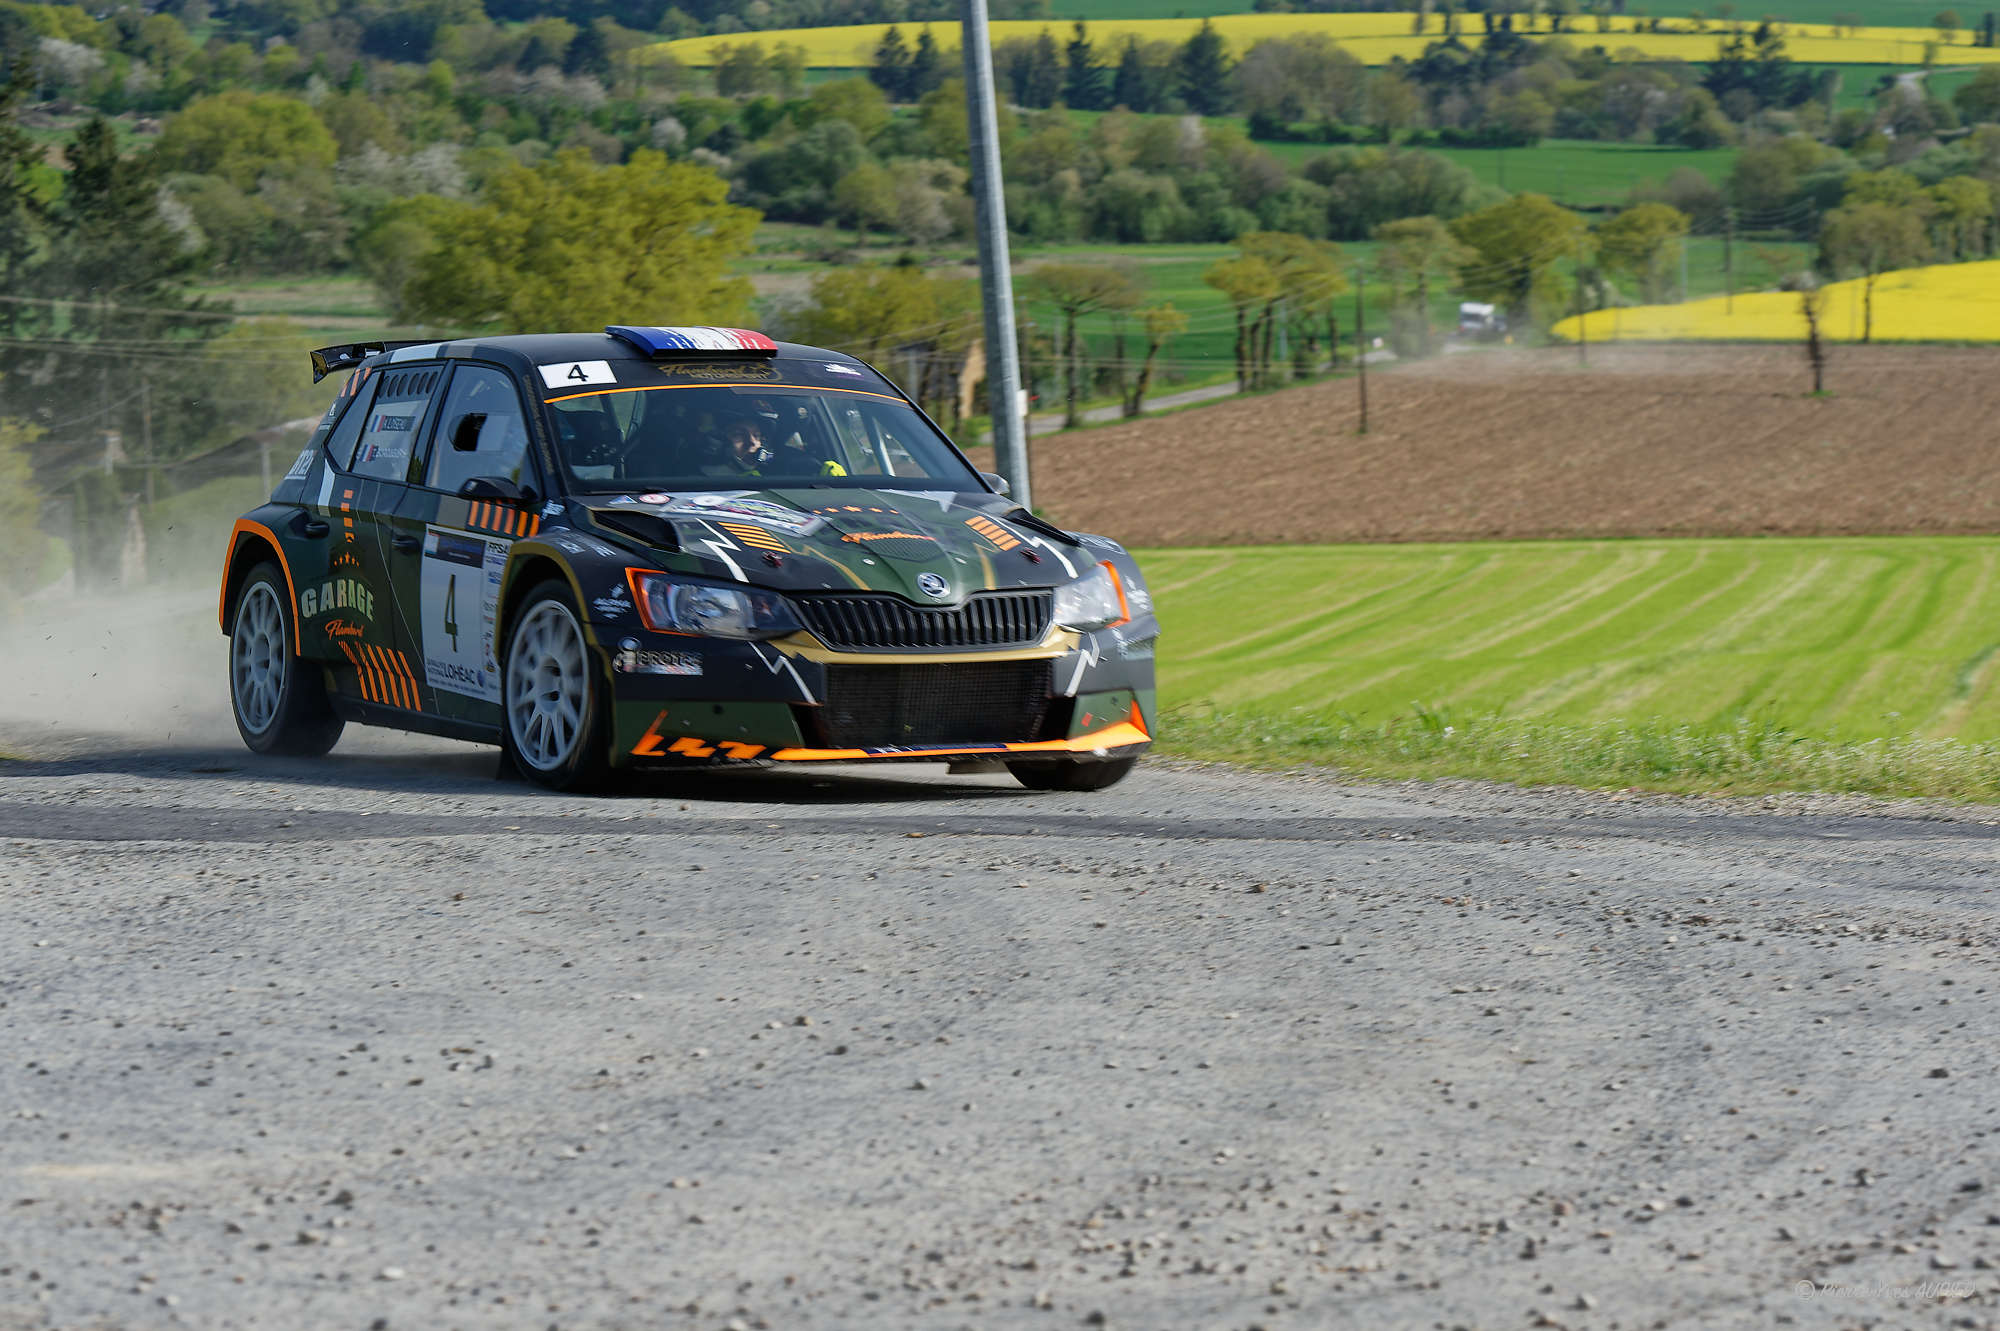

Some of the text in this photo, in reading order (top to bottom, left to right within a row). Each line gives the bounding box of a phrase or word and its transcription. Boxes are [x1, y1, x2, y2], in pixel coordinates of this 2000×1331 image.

[566, 363, 589, 382] 4
[301, 579, 374, 621] GARAGE
[444, 574, 458, 653] 4
